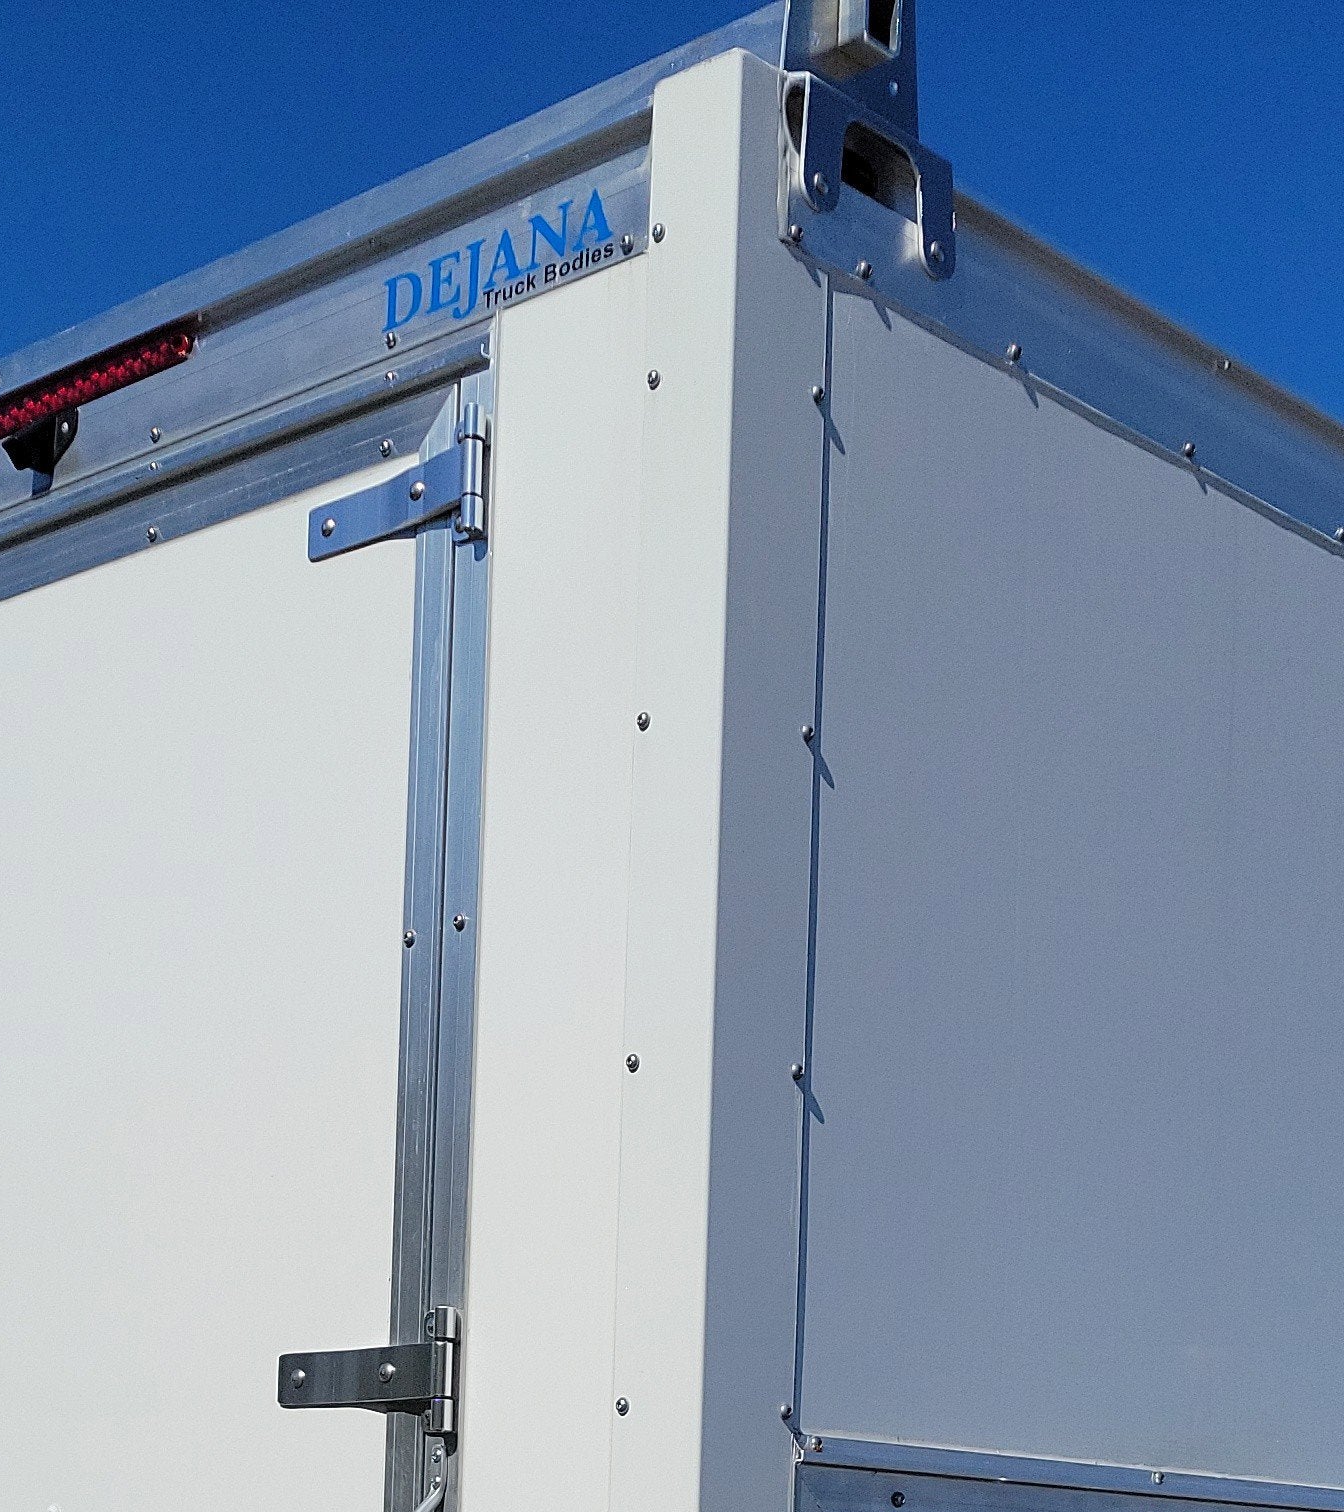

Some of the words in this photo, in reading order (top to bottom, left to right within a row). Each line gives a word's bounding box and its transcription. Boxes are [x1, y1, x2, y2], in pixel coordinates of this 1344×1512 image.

[382, 187, 615, 332] DEJANA
[483, 272, 536, 309] Truck
[543, 240, 615, 284] Bodies
